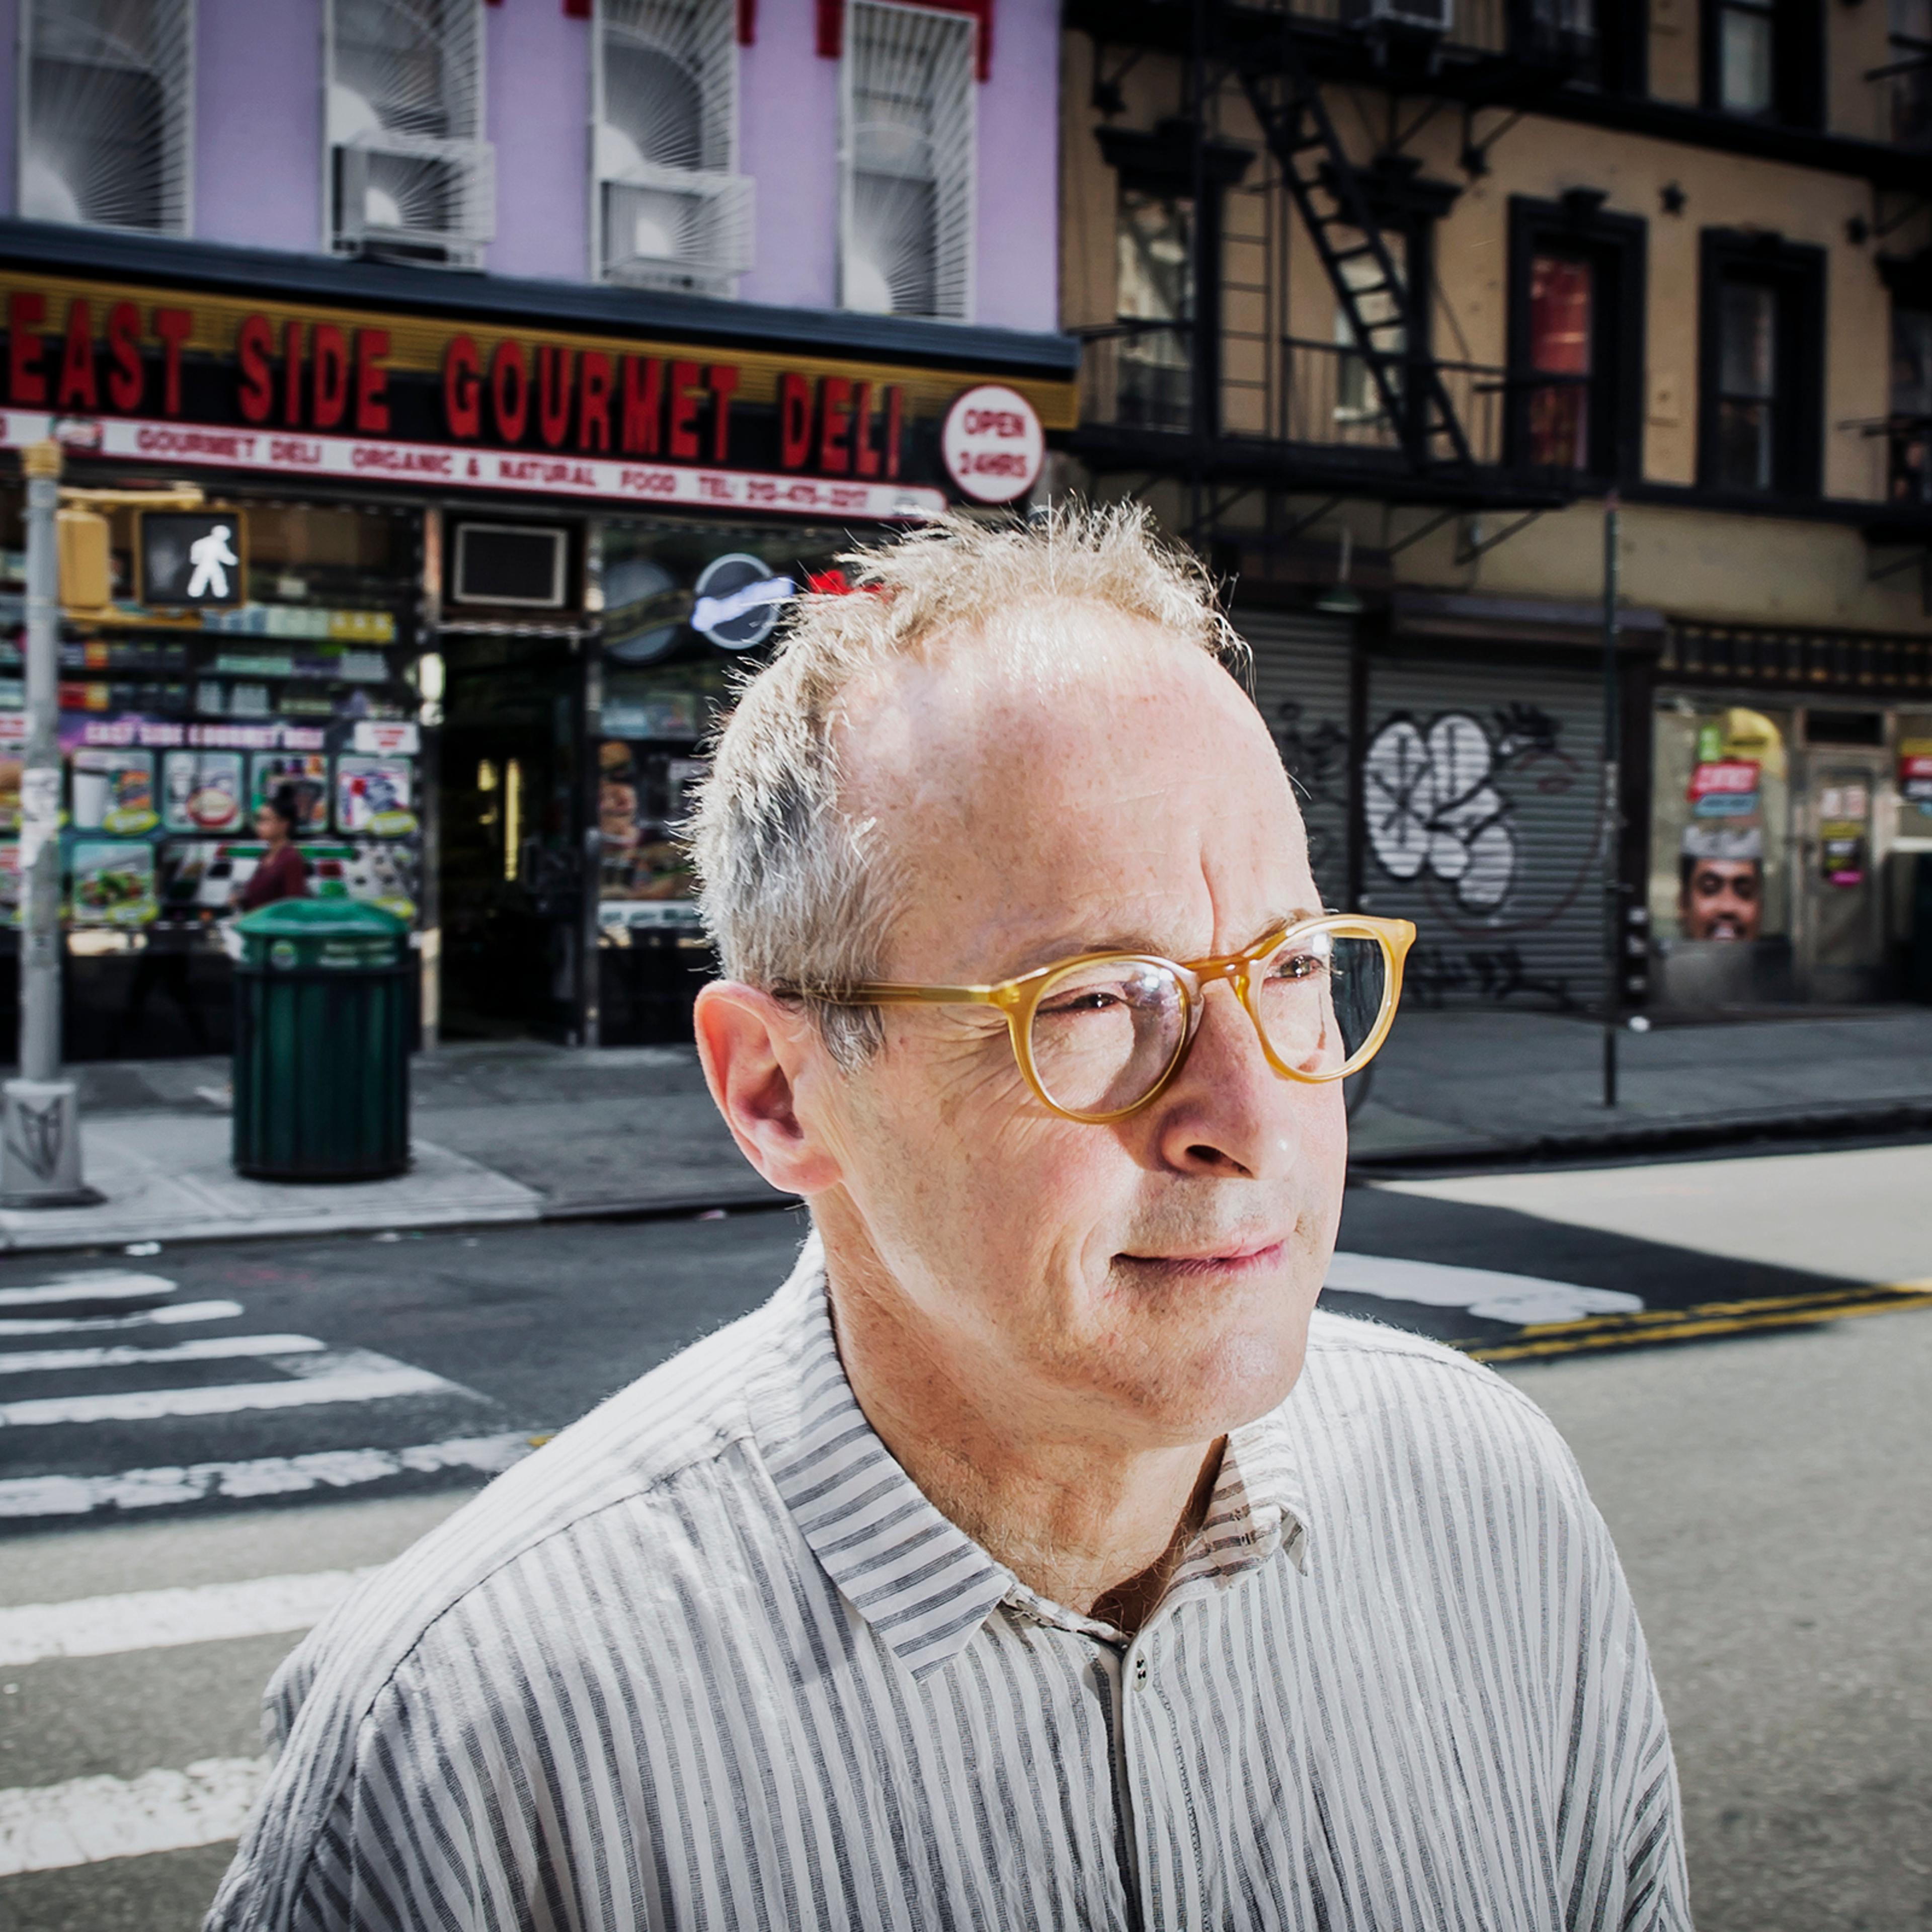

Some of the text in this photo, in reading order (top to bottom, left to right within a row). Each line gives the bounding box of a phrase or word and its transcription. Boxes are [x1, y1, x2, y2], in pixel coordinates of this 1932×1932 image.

[9, 291, 904, 478] EAST SIDE GOURMET DELI
[964, 409, 1026, 438] OPEN
[137, 429, 255, 459] GOURMET
[271, 440, 321, 463] DELI
[352, 448, 452, 475] ORGANIC
[467, 456, 480, 477] &
[500, 460, 597, 487] NATURAL
[621, 470, 677, 493] FOOD
[959, 451, 1027, 478] 24HRS
